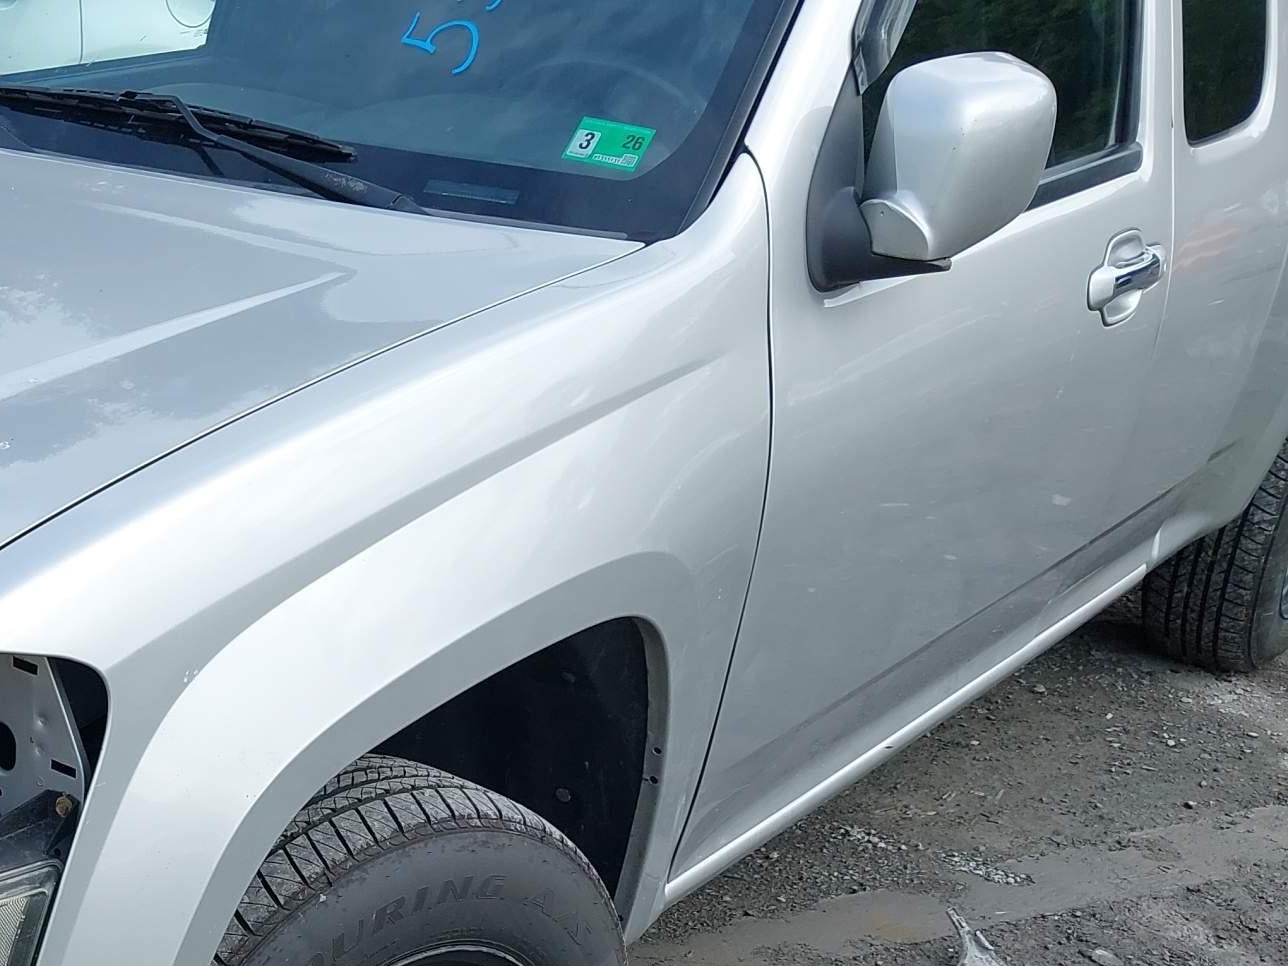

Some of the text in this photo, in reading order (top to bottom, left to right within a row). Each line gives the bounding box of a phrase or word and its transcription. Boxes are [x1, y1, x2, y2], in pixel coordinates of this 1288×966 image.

[399, 0, 504, 77] 5
[577, 131, 646, 151] 3 26
